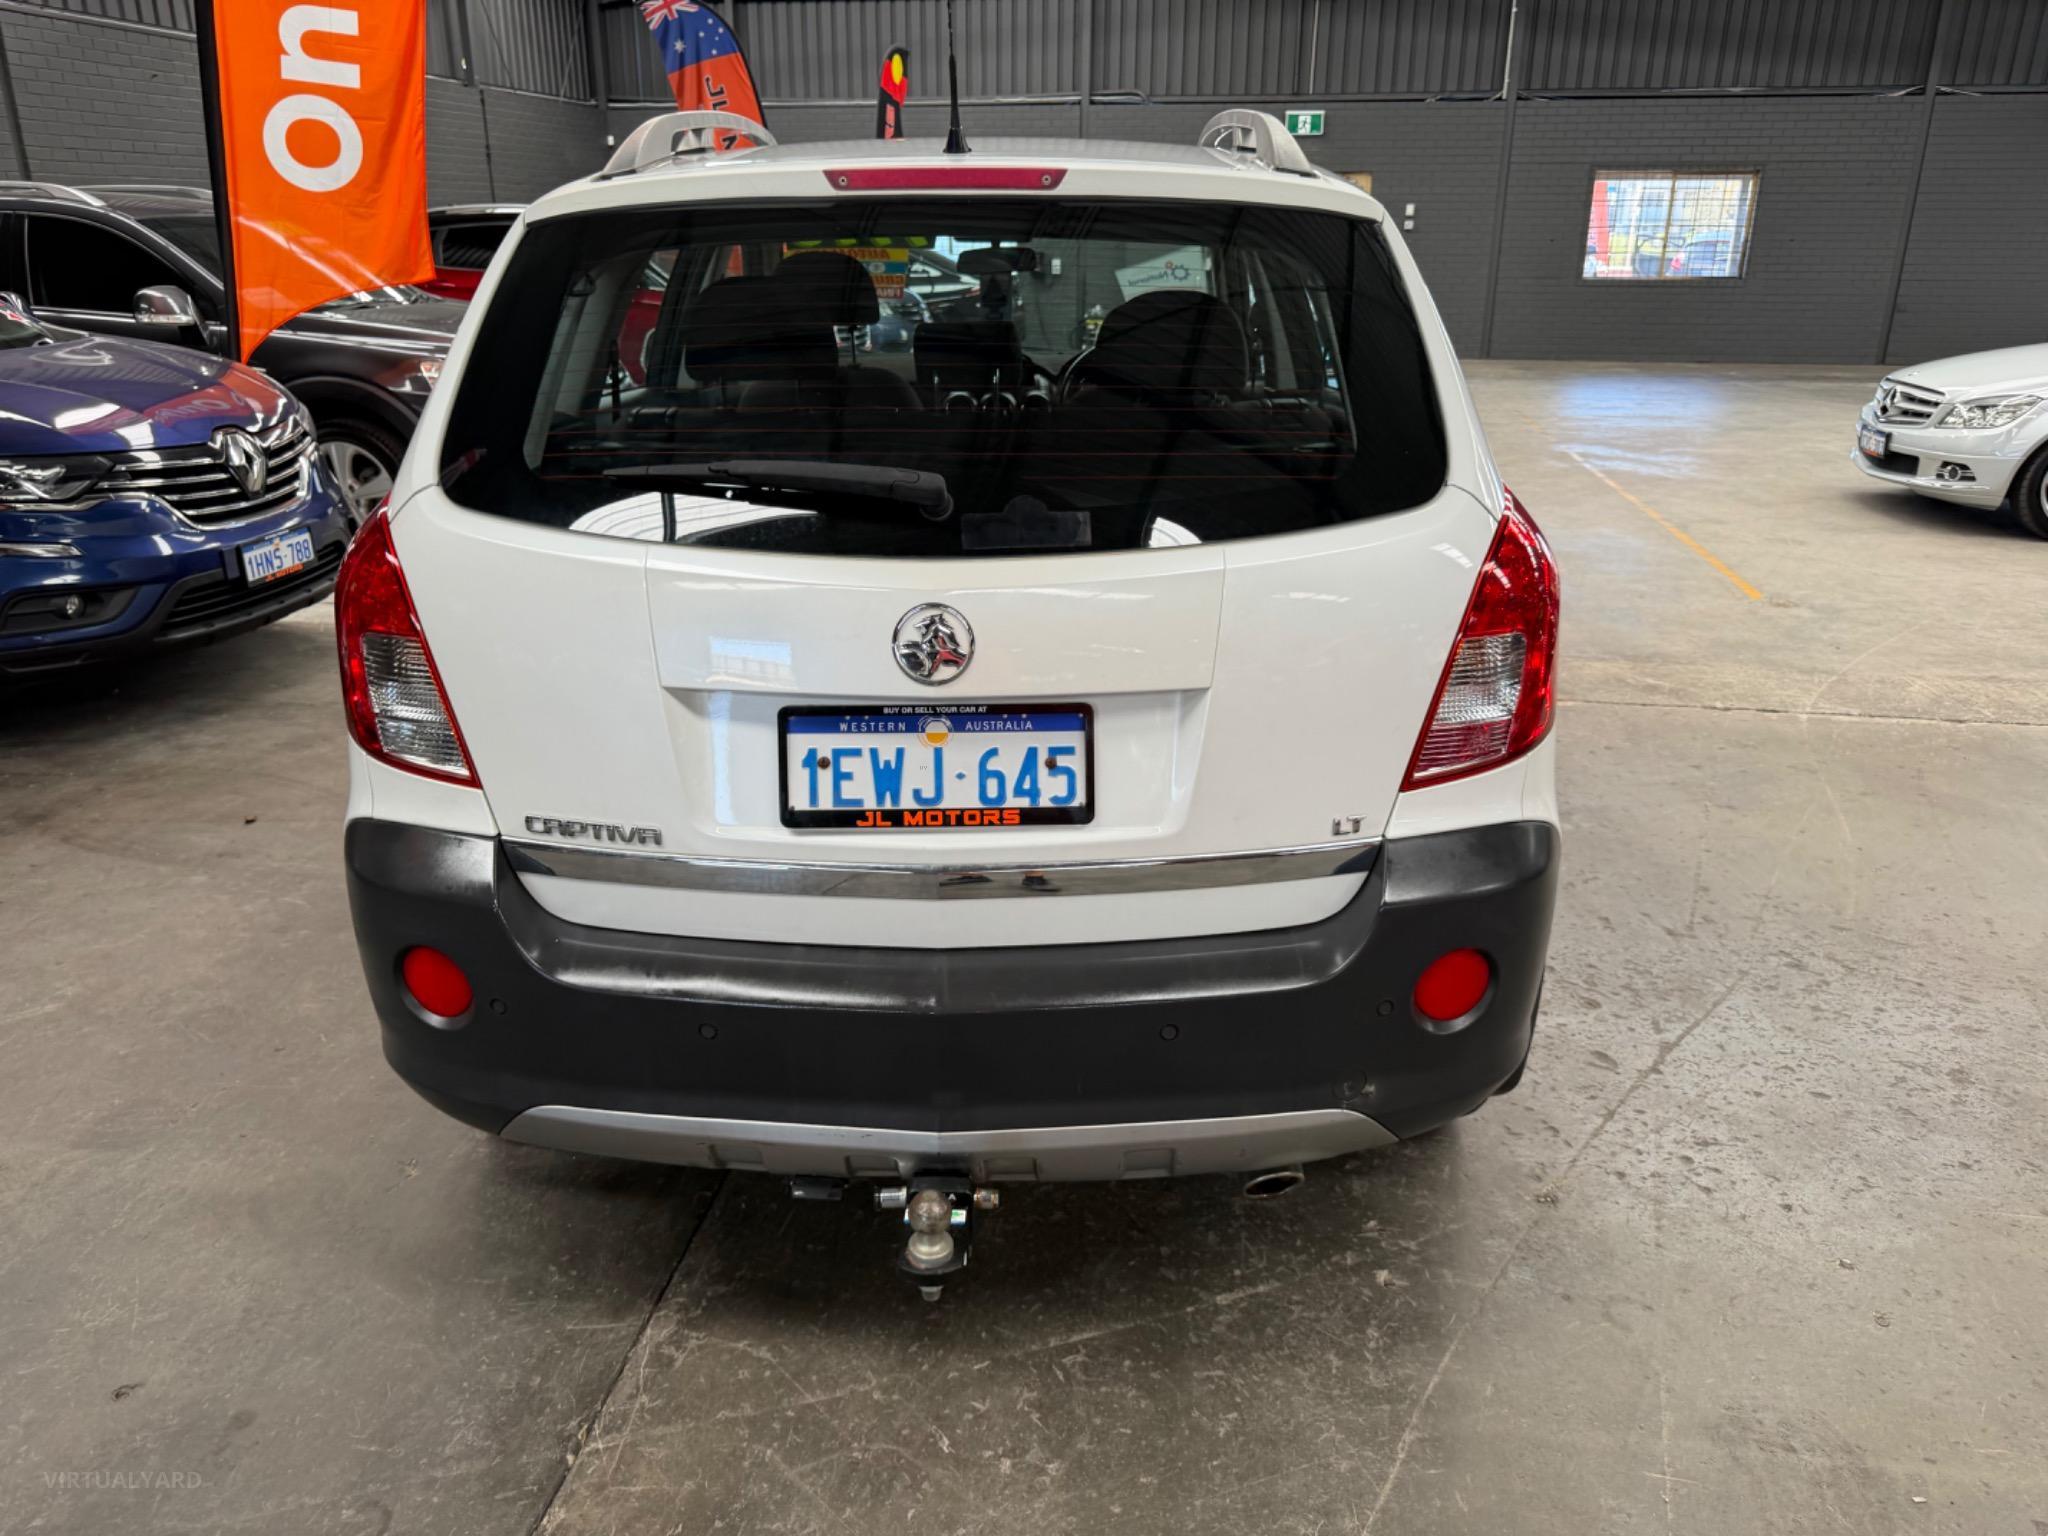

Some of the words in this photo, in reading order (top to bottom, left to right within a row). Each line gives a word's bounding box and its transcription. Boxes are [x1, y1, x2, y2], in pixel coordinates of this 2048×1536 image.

[883, 706, 900, 714] BUY
[902, 706, 913, 714] OR
[915, 706, 935, 714] SELL
[936, 706, 957, 714] YOUR
[959, 705, 976, 713] CAR
[977, 705, 988, 713] AT
[840, 722, 906, 732] WESTERN
[965, 720, 1033, 731] AUSTRALIA
[856, 811, 892, 827] JL
[903, 809, 1021, 827] MOTORS
[1331, 815, 1367, 836] LT
[524, 815, 663, 846] CAPTIVA
